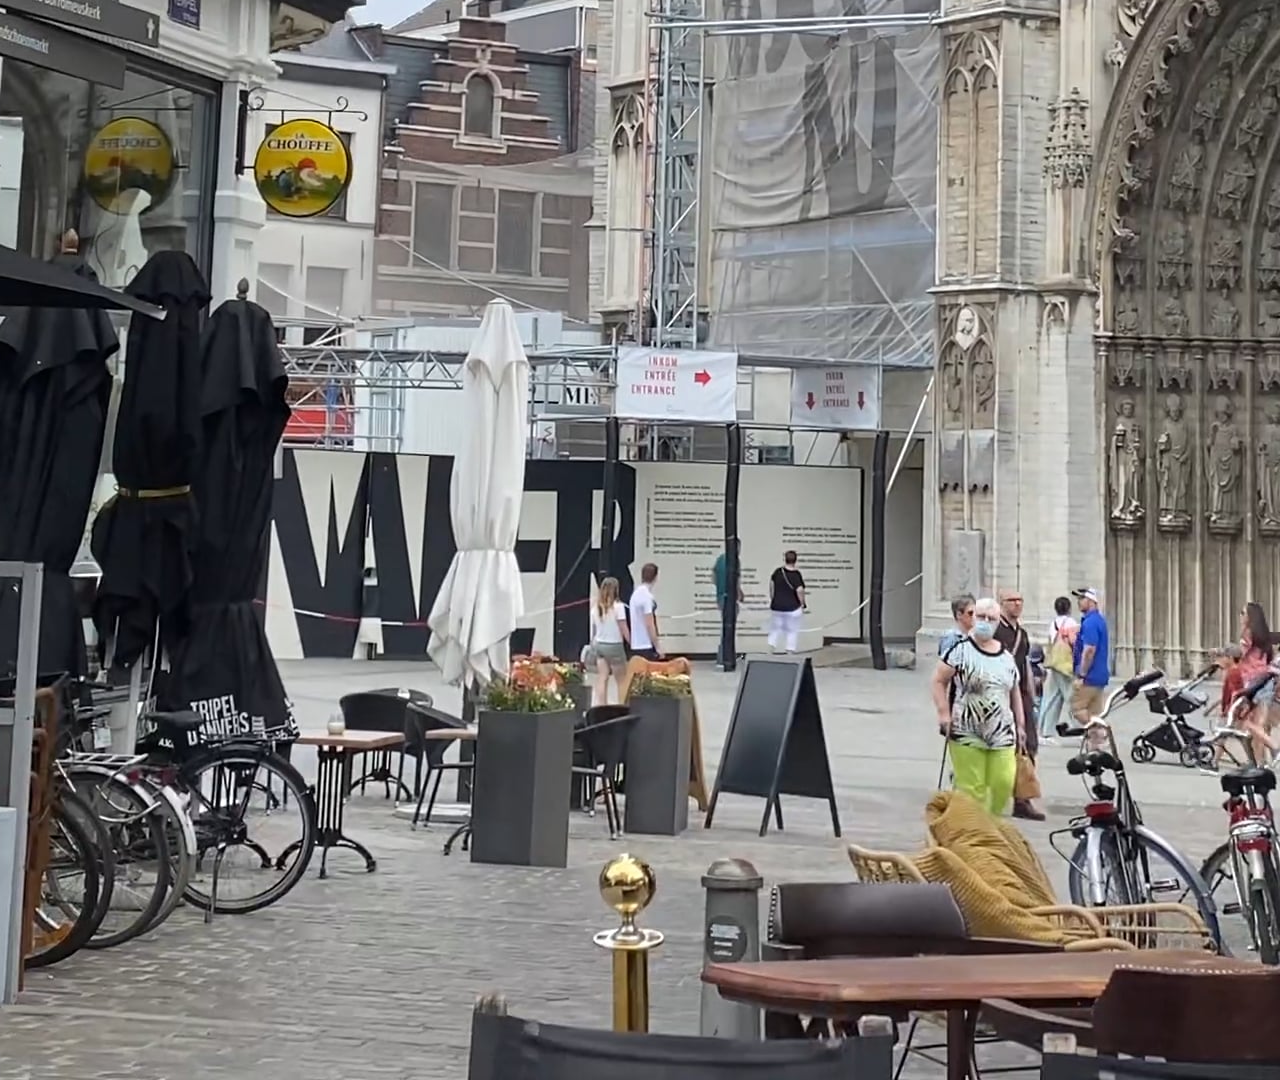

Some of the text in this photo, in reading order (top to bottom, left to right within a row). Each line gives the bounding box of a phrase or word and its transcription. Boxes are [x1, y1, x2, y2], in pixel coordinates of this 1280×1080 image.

[267, 139, 333, 152] CHOUFFE
[649, 356, 677, 367] INKOM
[645, 369, 676, 381] ENTRÉE
[631, 384, 675, 395] ENTRANCE
[190, 695, 238, 722] TRIPEL
